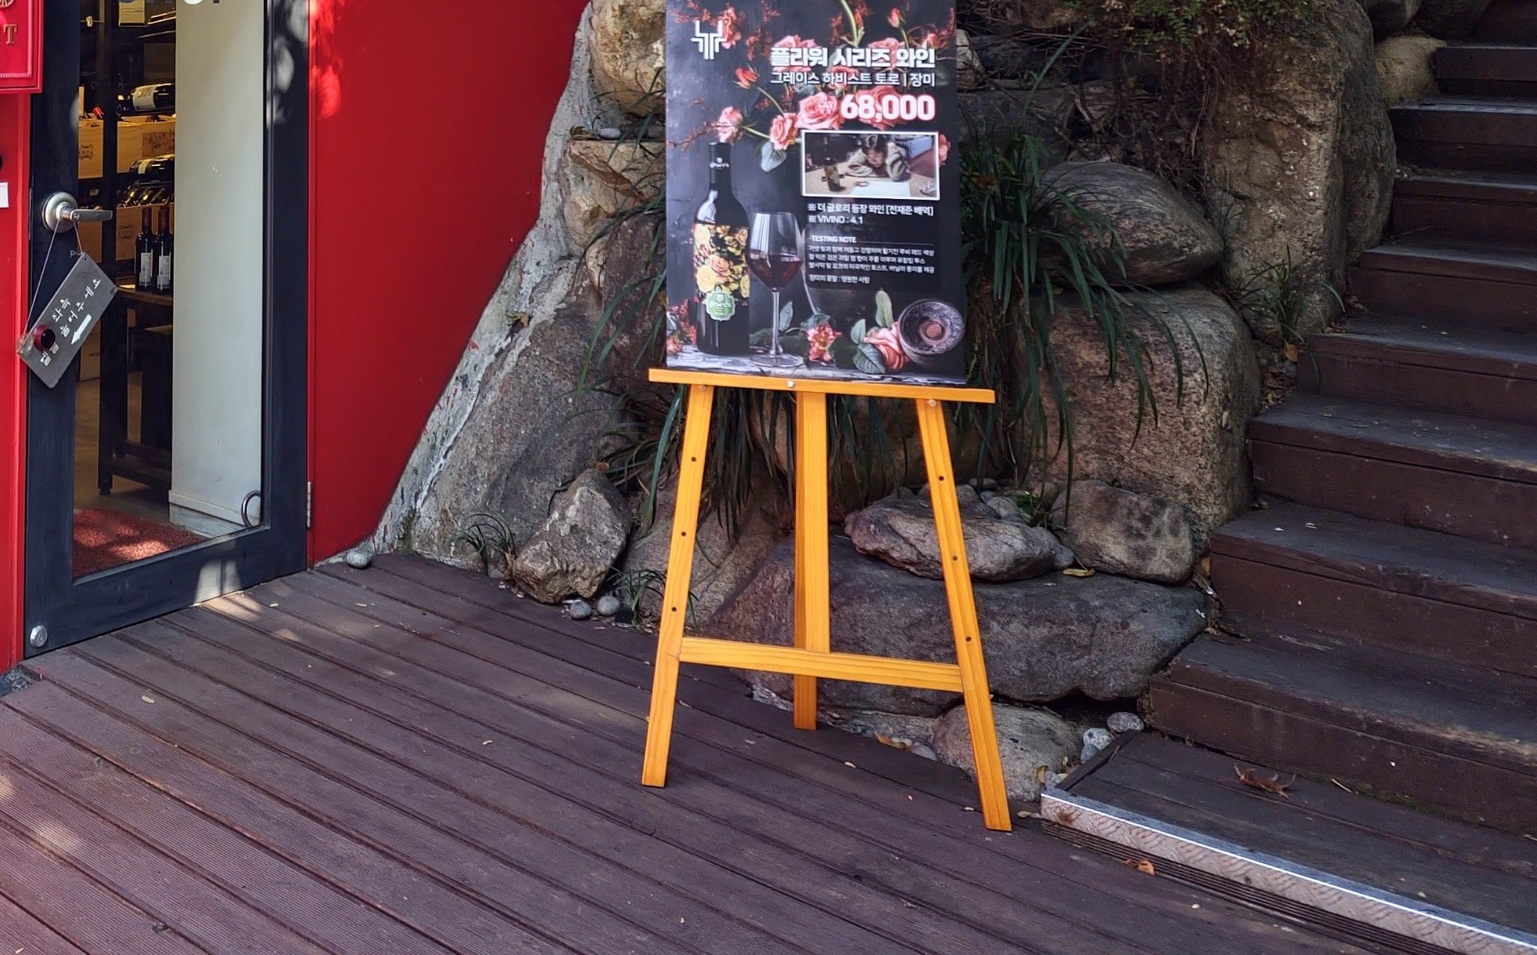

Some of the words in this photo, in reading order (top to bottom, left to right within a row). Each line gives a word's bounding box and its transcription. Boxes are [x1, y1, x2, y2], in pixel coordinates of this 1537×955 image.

[770, 47, 828, 67] 플라워
[833, 47, 892, 68] 시리즈
[896, 48, 936, 69] 와인
[770, 72, 820, 85] 그레이스
[823, 72, 872, 85] 하비스트
[875, 73, 901, 86] 토로
[910, 74, 936, 87] 장미
[840, 94, 936, 123] 68,000
[817, 203, 826, 212] 더
[851, 204, 868, 214] 등장
[868, 205, 885, 215] 와인
[818, 215, 845, 224] VIVINO
[850, 216, 864, 225] 4.1
[839, 236, 857, 244] NOTE
